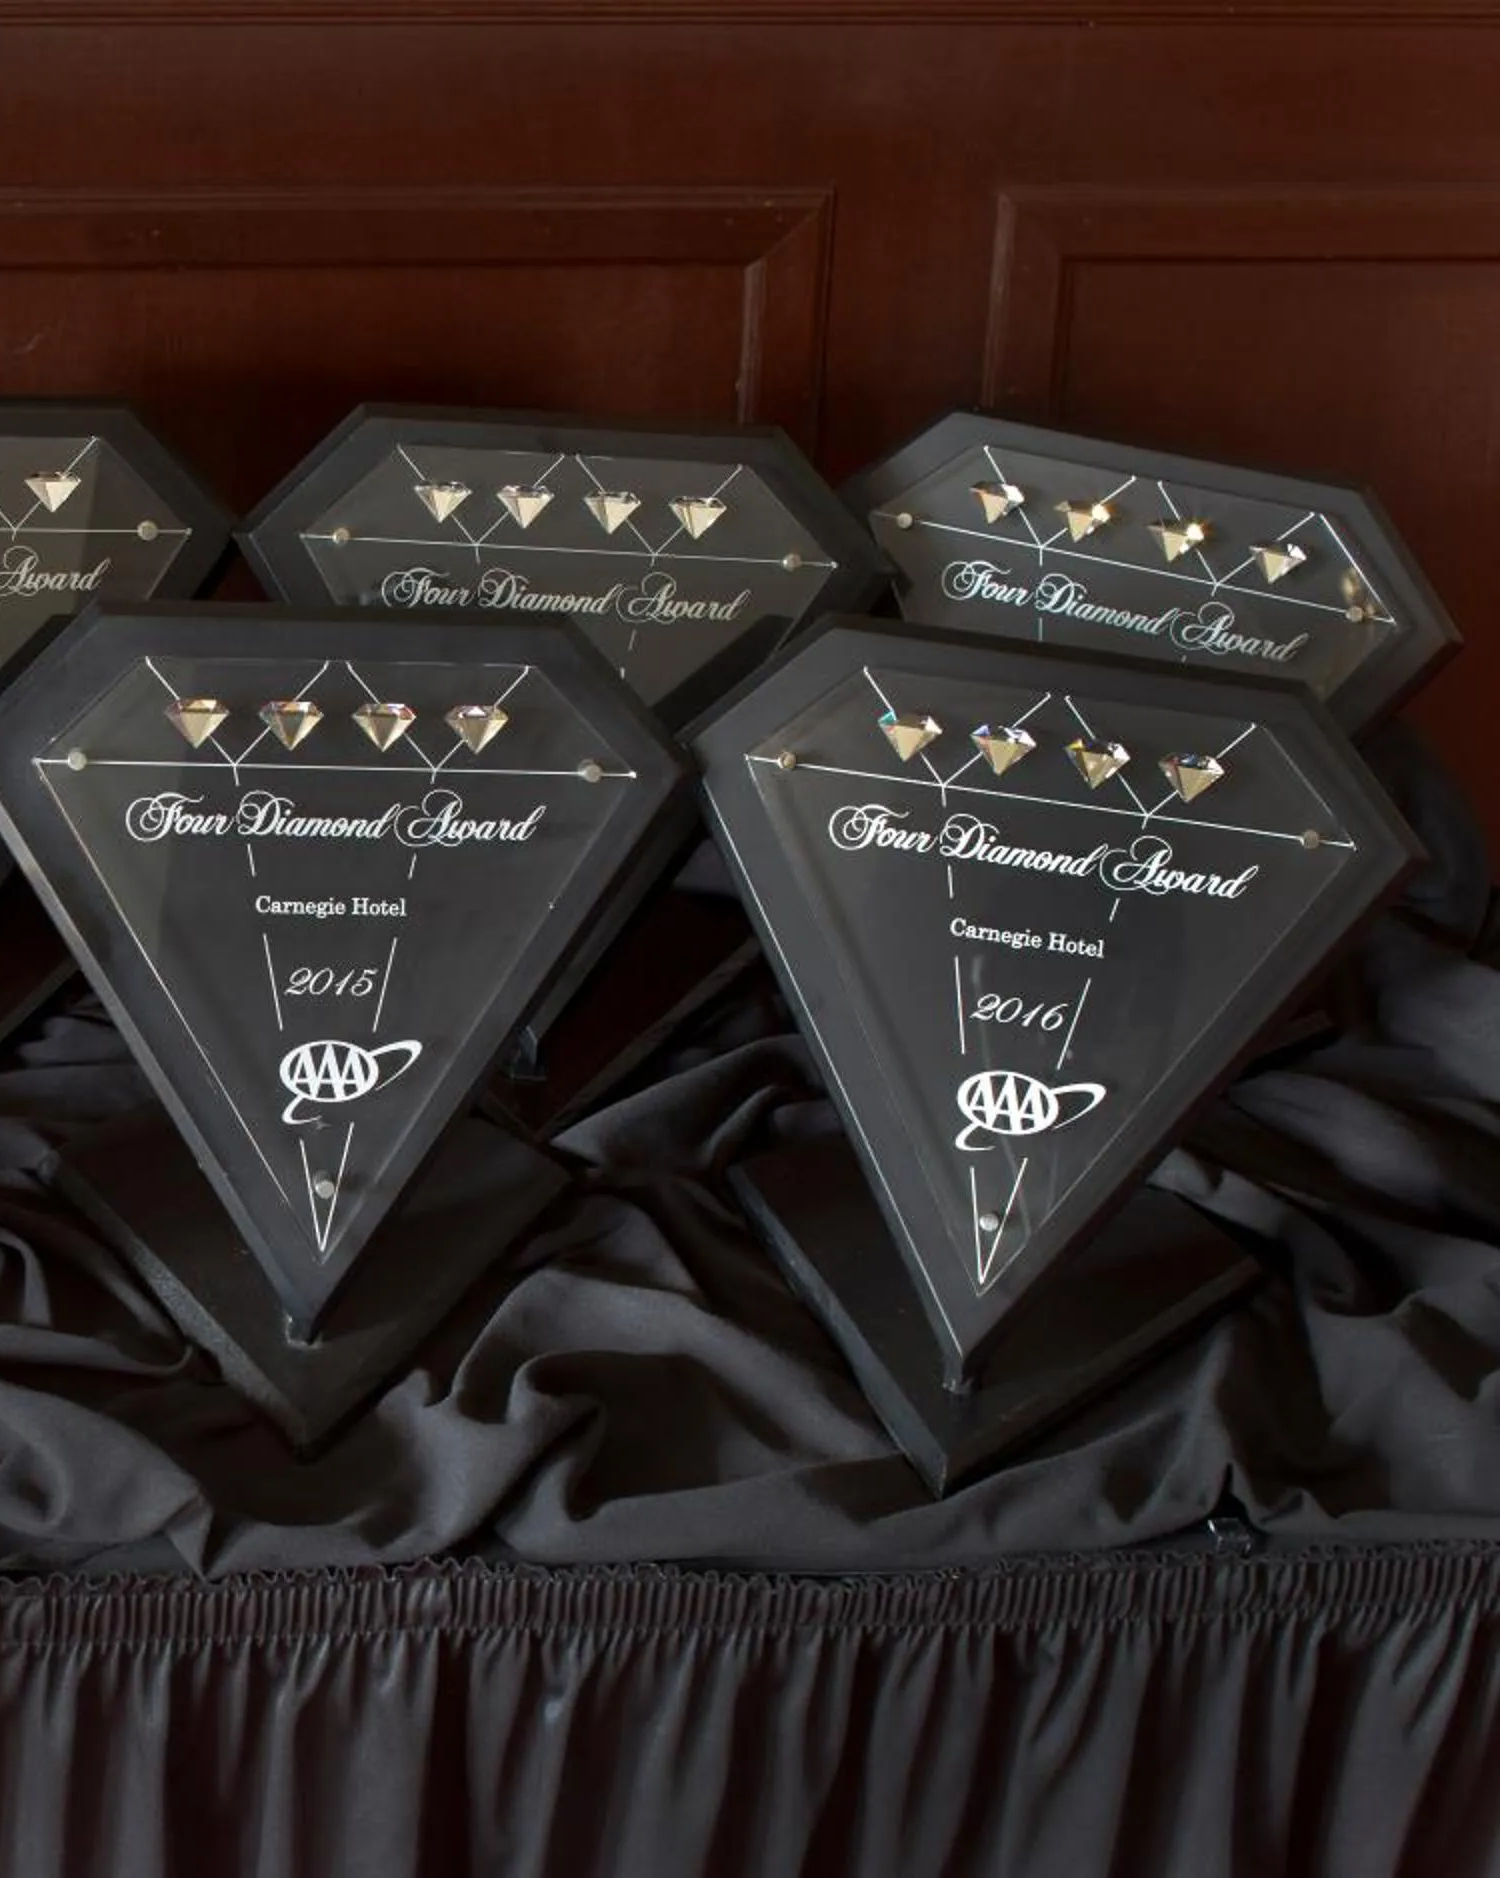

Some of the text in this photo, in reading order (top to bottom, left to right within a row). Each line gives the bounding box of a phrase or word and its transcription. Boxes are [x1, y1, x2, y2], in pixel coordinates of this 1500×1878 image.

[381, 567, 751, 624] Four Diamond Award
[941, 560, 1309, 661] Four Diamond Award
[125, 789, 546, 847] Four Diamond Award
[828, 803, 1259, 899] Four Diamond Award
[255, 895, 407, 919] Carnegie Hotel
[950, 917, 1105, 959] Carnegie Hotel
[284, 967, 379, 997] 2015
[969, 993, 1069, 1031] 2016
[286, 1040, 374, 1101] AAA
[962, 1071, 1053, 1134] AAA
